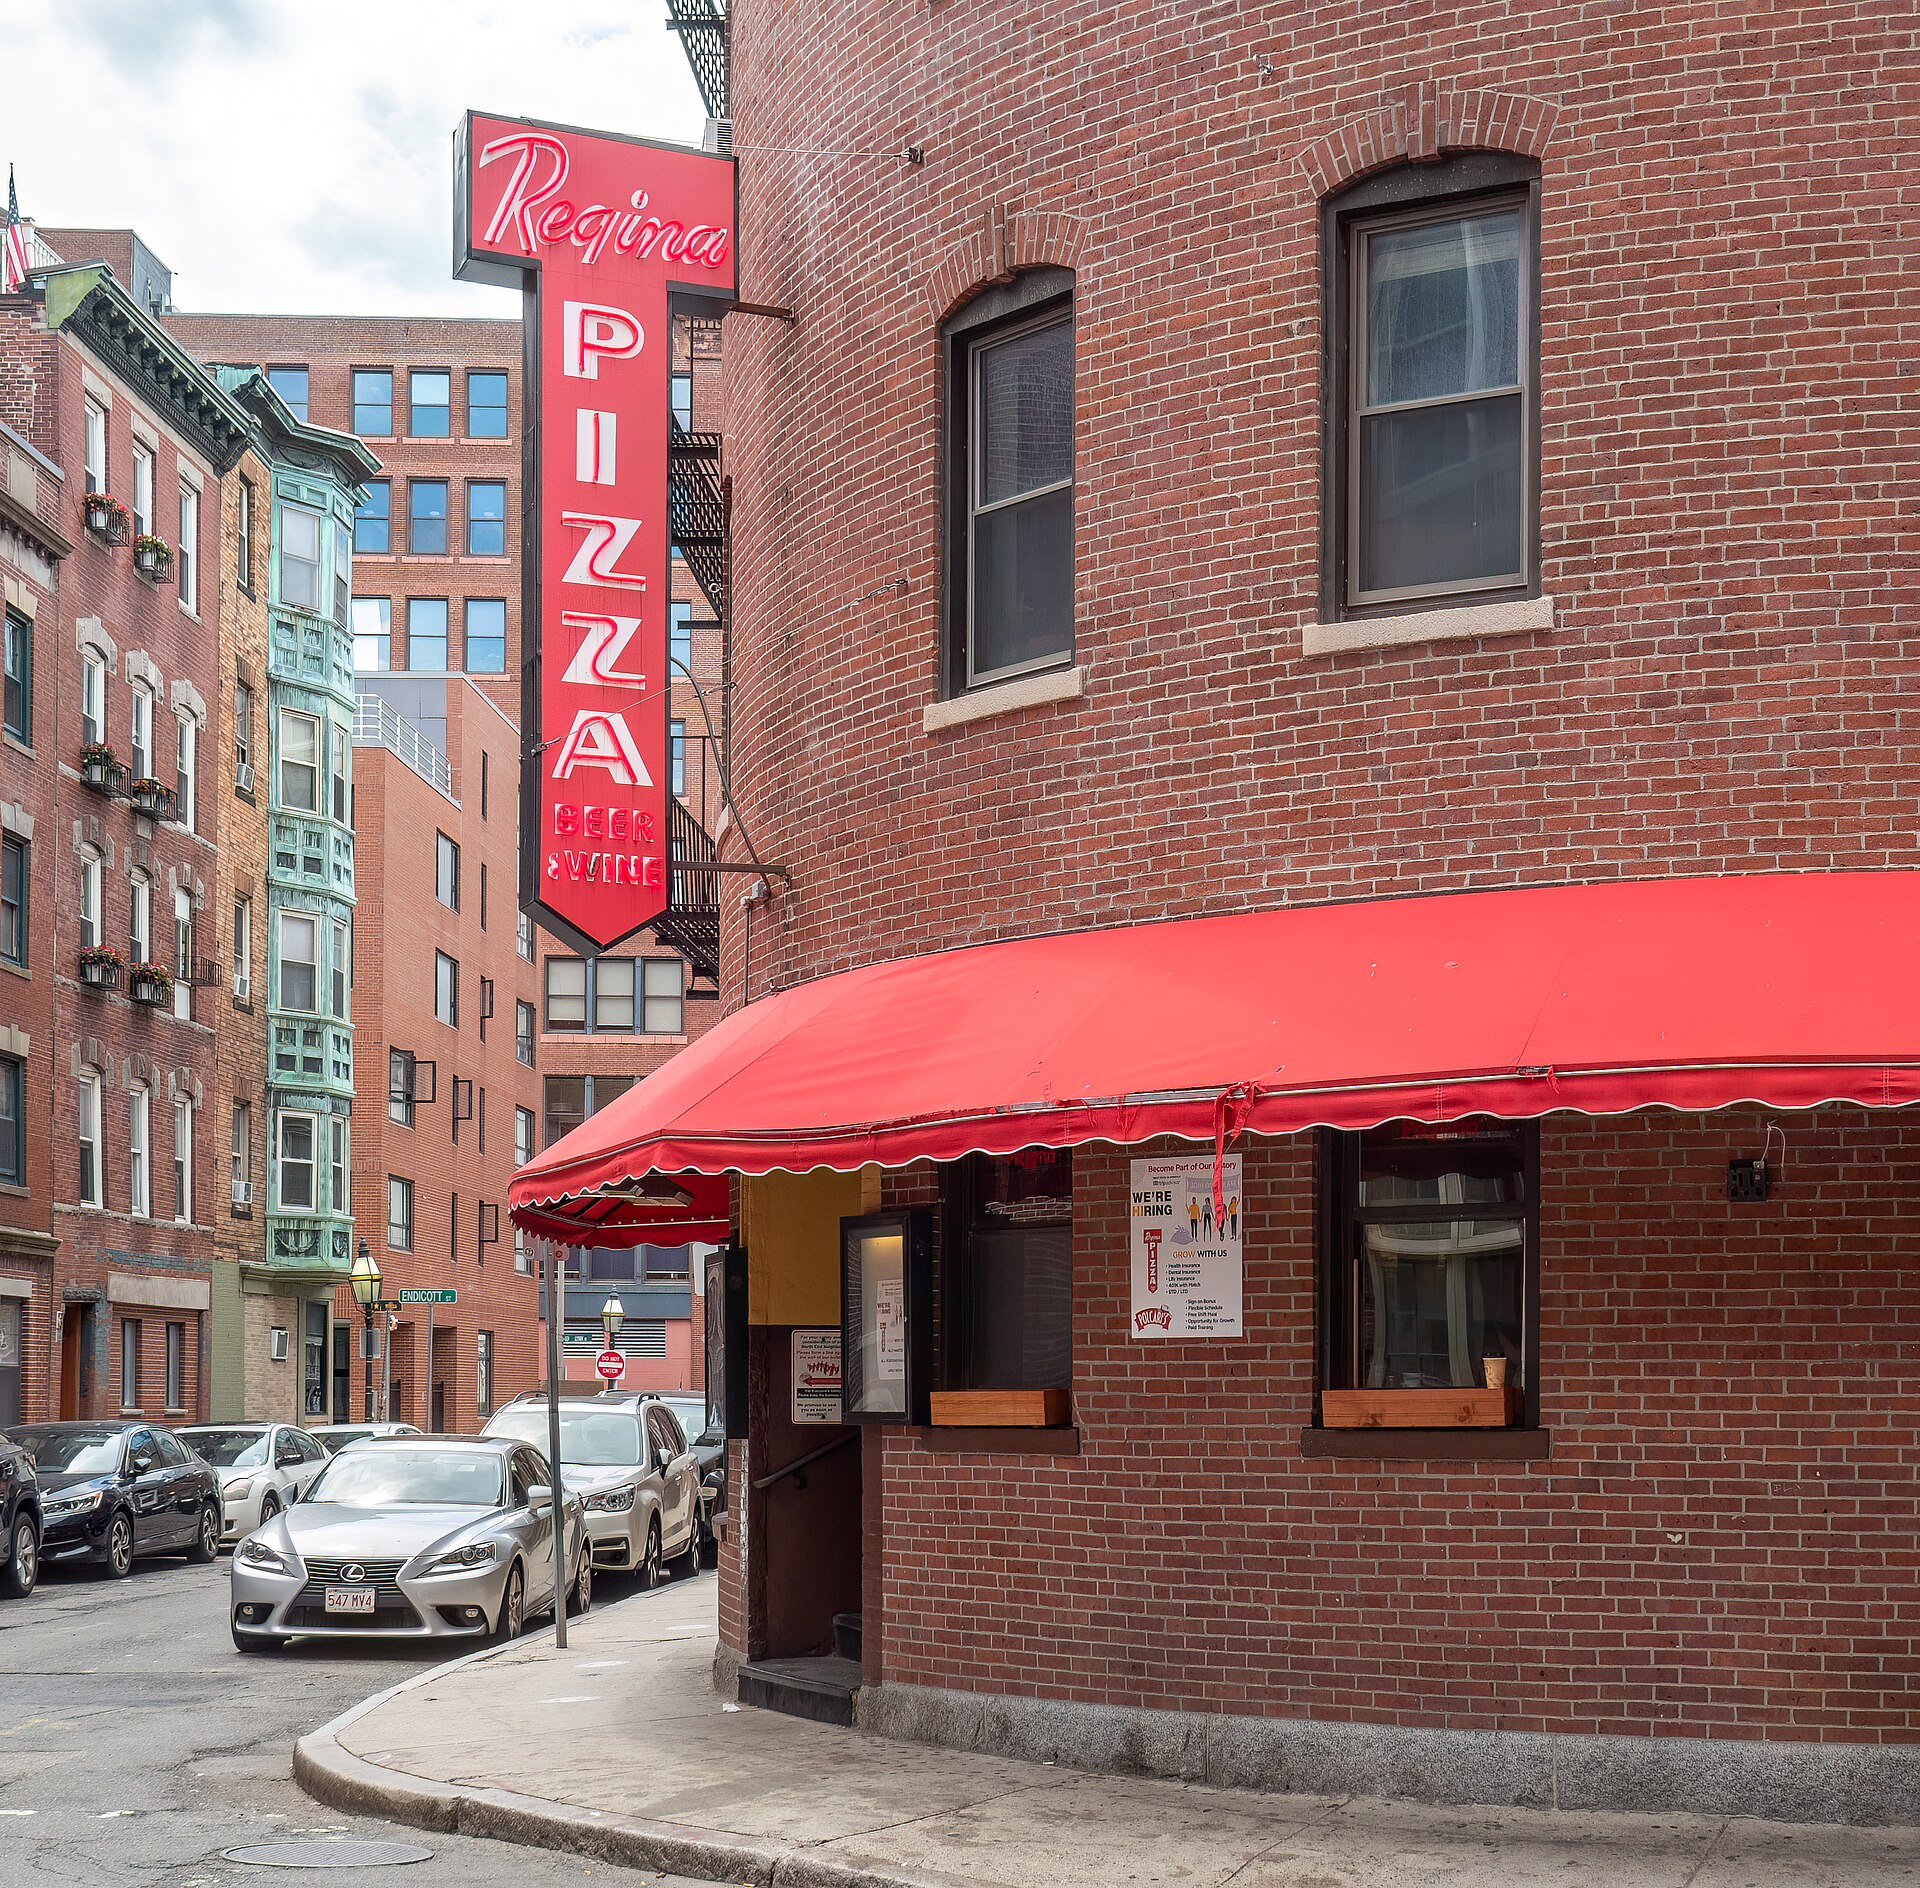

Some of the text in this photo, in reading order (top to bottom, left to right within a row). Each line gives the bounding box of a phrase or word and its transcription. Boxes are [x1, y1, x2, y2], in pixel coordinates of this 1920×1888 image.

[479, 132, 728, 268] Regina
[552, 300, 654, 787] PIZZA
[554, 803, 655, 842] BEER
[1213, 1162, 1236, 1171] tory
[1132, 1205, 1172, 1216] HIRING
[402, 1291, 442, 1301] ENDICOTT
[329, 1594, 371, 1606] 547 MV4
